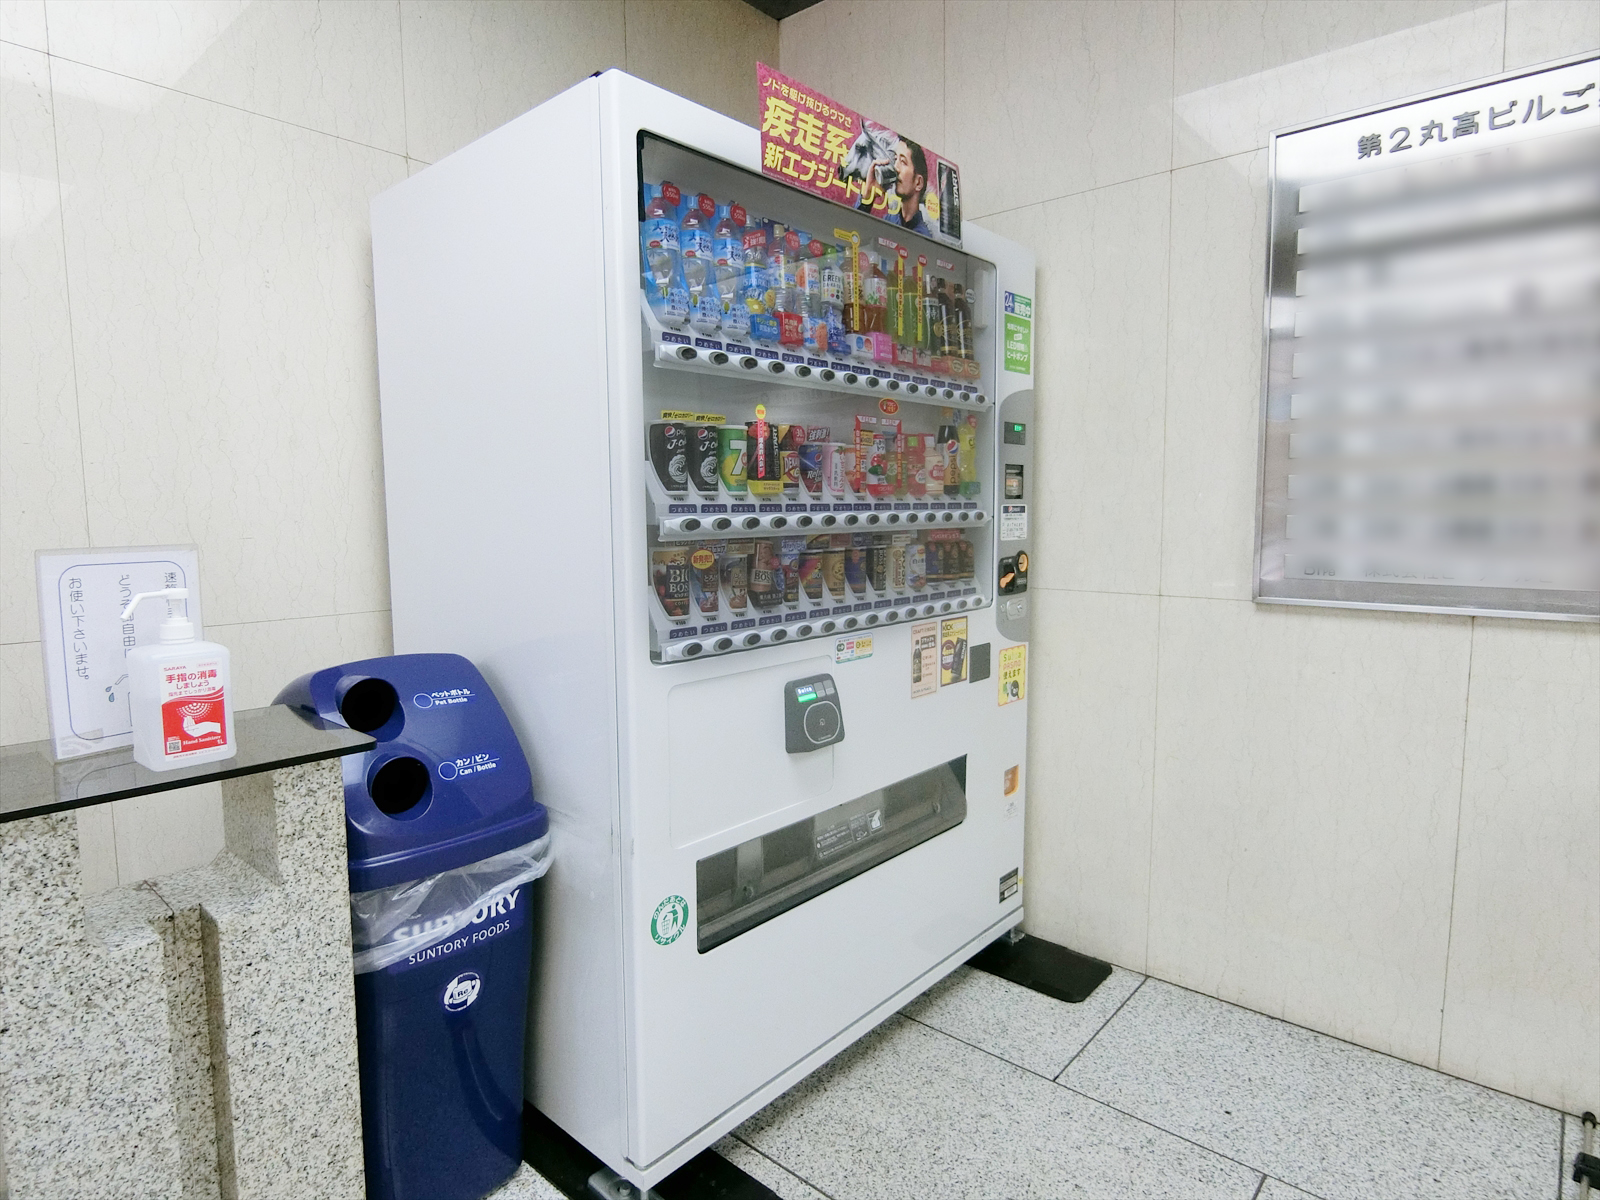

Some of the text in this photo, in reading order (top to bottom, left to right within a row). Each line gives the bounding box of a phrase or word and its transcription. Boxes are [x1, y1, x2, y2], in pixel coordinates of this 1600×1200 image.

[762, 78, 852, 128] ノドを駆け抜けるウマさ
[1357, 83, 1600, 160] 第2丸高ビルご
[762, 96, 854, 168] 疾走系
[764, 142, 902, 215] 新エナジードリンク
[664, 335, 689, 344] つめたい
[697, 341, 720, 349] つめたい
[728, 346, 750, 354] つめたい
[757, 351, 778, 359] つめたい
[783, 356, 804, 364] つめたい
[669, 583, 688, 593] BOS
[760, 617, 780, 625] つめたい
[786, 613, 806, 621] つめたい
[68, 577, 90, 681] お使い下さいませ。
[703, 625, 726, 633] つめたい
[733, 621, 754, 629] つめたい
[671, 630, 696, 638] つめたい
[166, 669, 217, 684] 手指の消毒
[176, 680, 210, 690] しましょう
[431, 688, 471, 698] ペットボトル
[408, 919, 510, 965] SUNTORY FOODS
